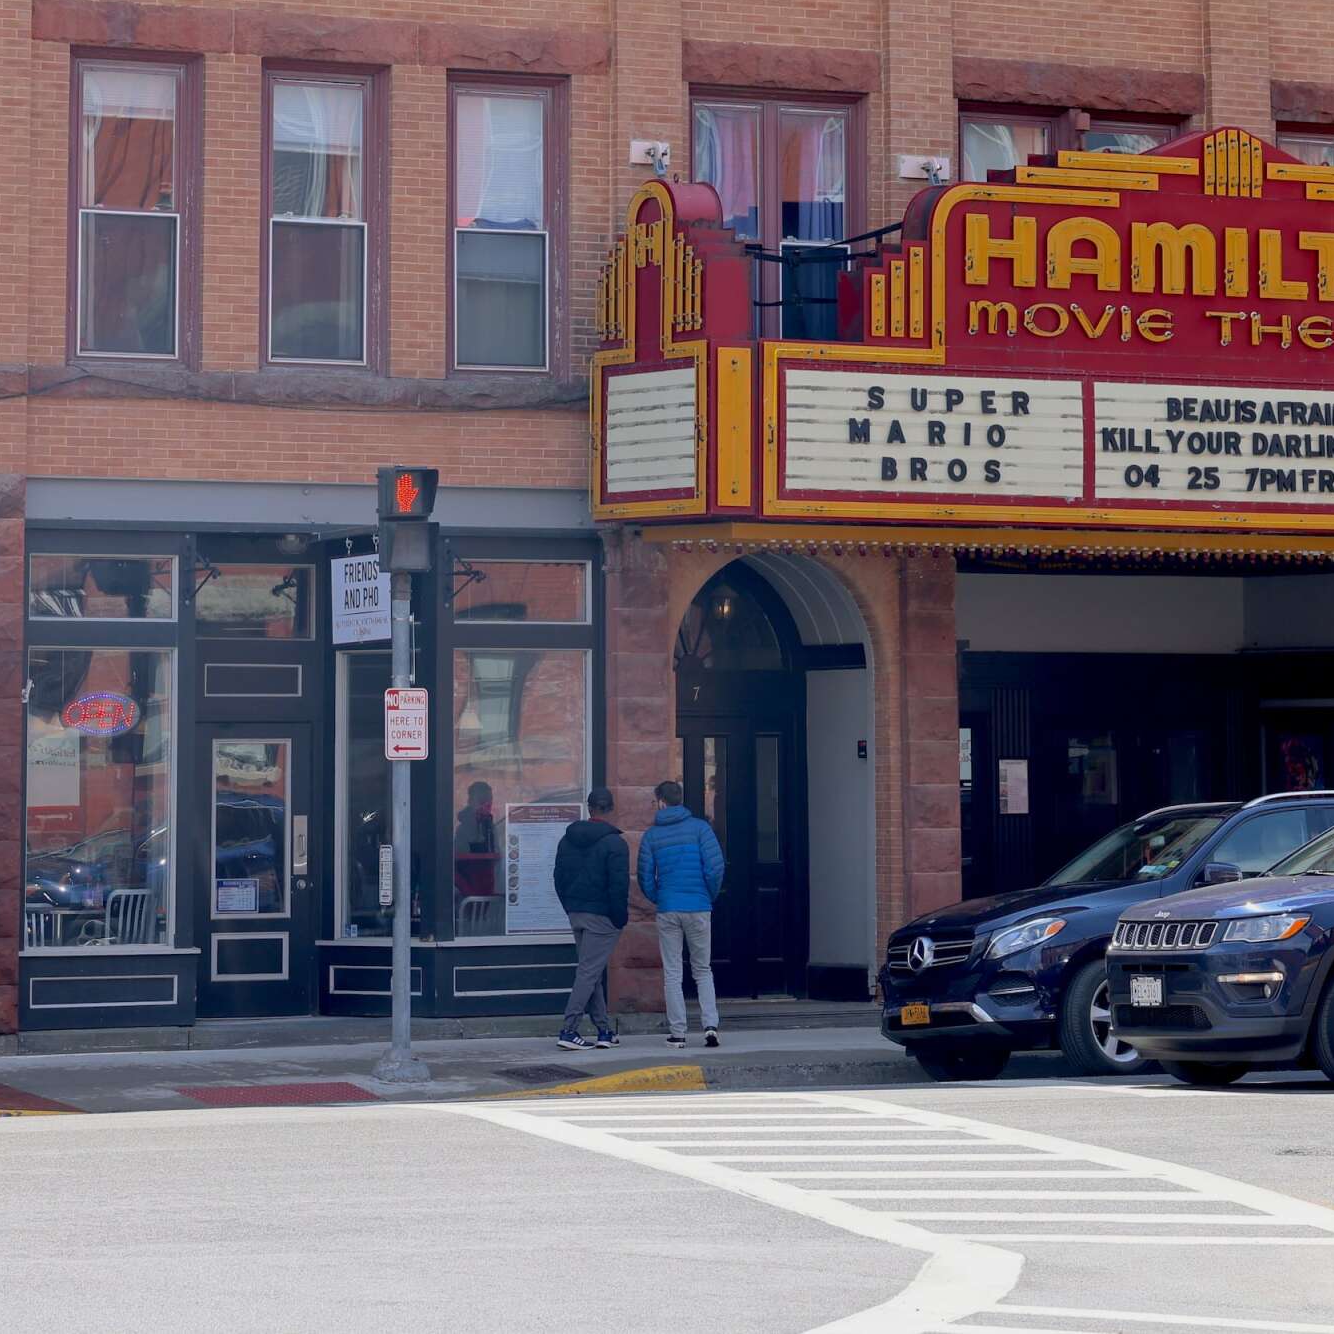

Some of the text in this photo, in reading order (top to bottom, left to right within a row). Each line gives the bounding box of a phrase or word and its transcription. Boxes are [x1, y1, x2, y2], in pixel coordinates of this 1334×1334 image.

[968, 299, 1175, 342] MOVIE
[867, 386, 1030, 416] SUPER
[1166, 397, 1231, 423] BEAU
[1234, 400, 1256, 423] IS
[849, 418, 1007, 447] MARIO
[1101, 427, 1160, 453] KILL
[1166, 429, 1242, 456] YOUR
[881, 457, 1001, 484] BROS
[1124, 464, 1160, 488] 04
[1187, 466, 1220, 490] 25
[1245, 467, 1296, 493] 7PM
[344, 560, 378, 584] FRIENDS
[344, 586, 379, 610] AND PHO
[387, 693, 425, 707] NO PARKING
[65, 702, 135, 728] OPEN
[390, 716, 424, 726] HERE TO
[391, 730, 423, 740] CORNER
